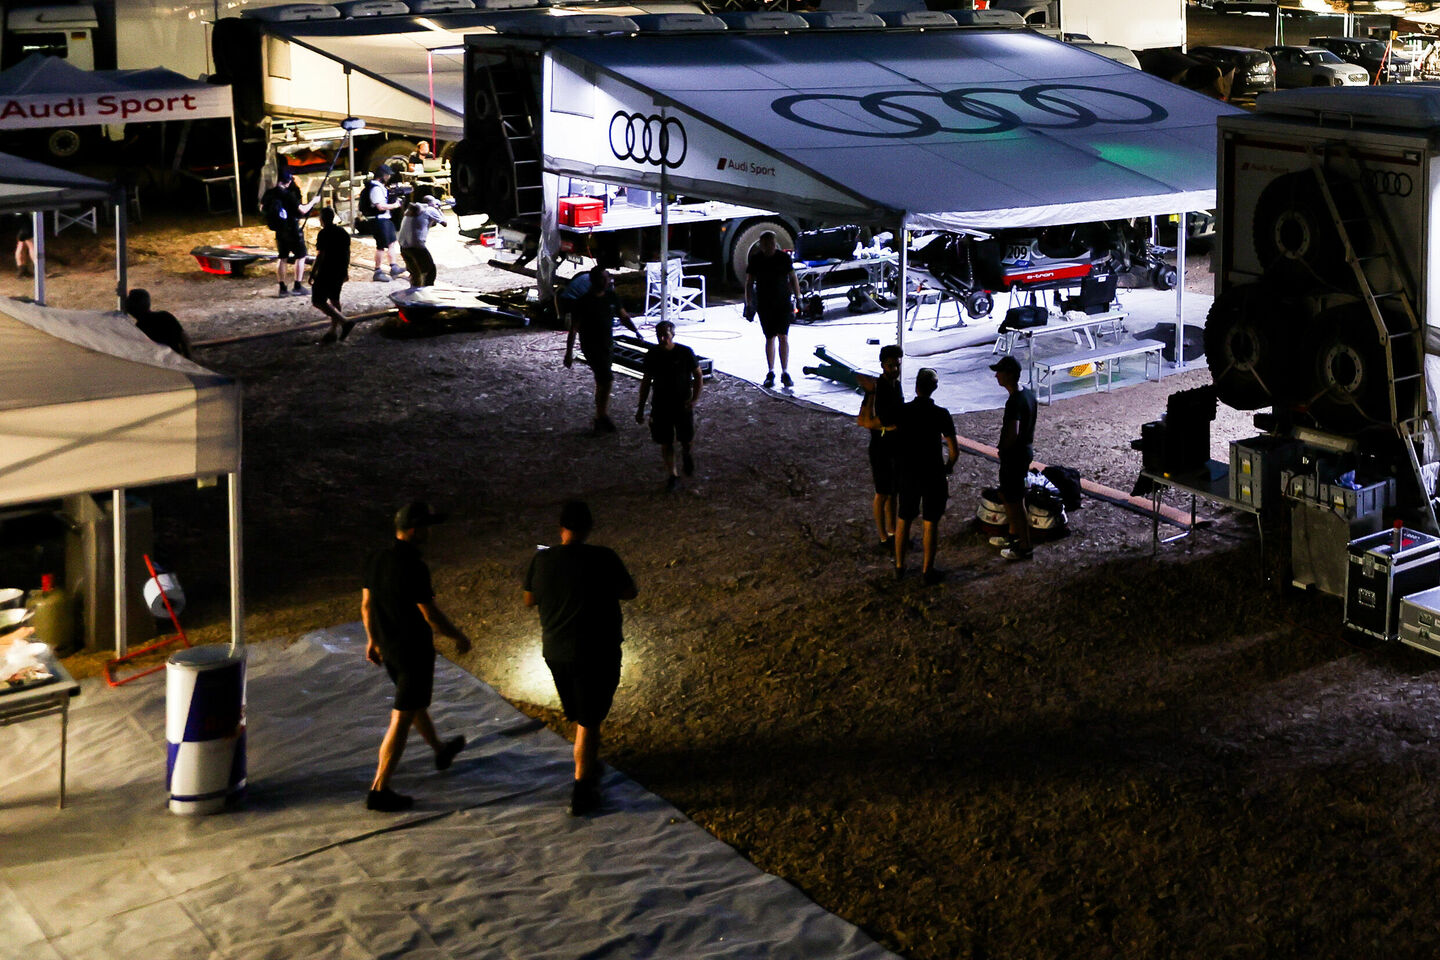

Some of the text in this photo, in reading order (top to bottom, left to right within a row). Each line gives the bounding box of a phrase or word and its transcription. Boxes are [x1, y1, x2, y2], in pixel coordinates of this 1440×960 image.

[0, 93, 198, 120] Audi Sport
[728, 158, 776, 177] Audi Sport
[1008, 245, 1028, 260] 209
[1027, 271, 1055, 280] e-tron
